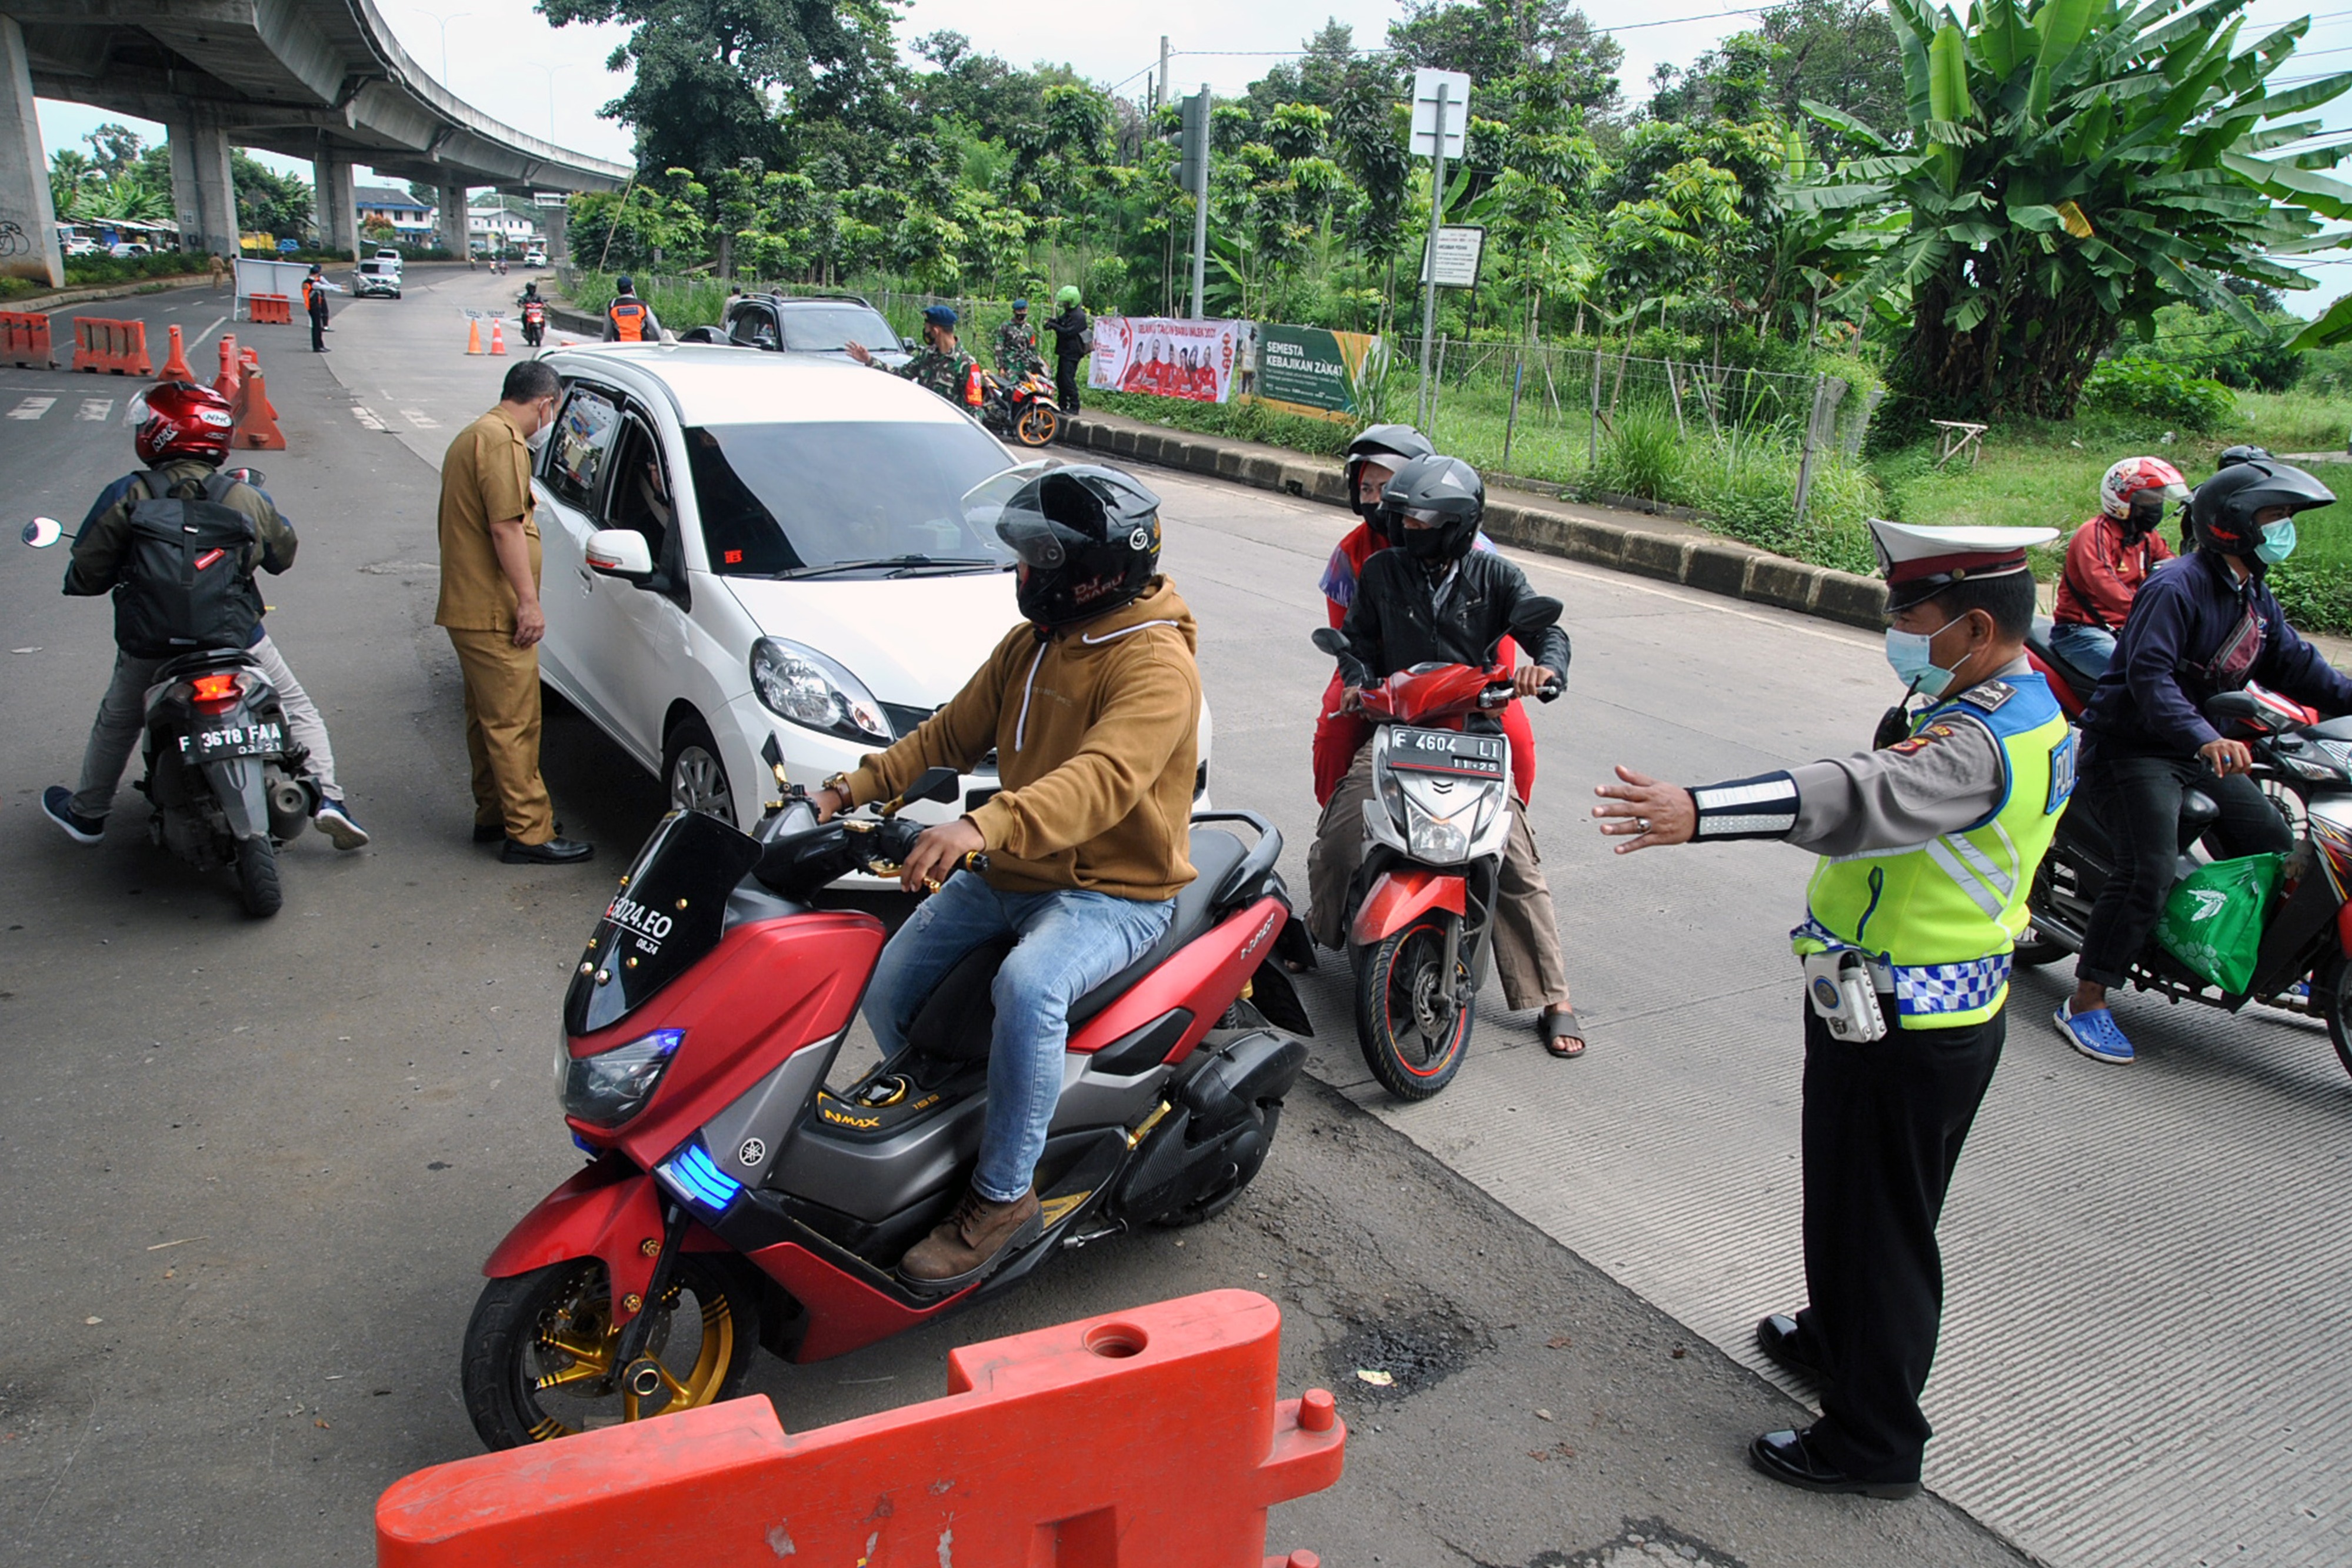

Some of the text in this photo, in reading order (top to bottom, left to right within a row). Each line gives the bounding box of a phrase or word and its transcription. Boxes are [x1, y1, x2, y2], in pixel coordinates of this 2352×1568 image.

[1267, 341, 1304, 357] SEMESTA
[1266, 355, 1313, 372] KEBAJIKAN
[206, 414, 228, 423] NHK
[152, 426, 175, 450] NHK
[179, 723, 281, 752] F 3678 FAA
[1395, 733, 1497, 758] F 4604 LI
[825, 1109, 880, 1128] NMAX
